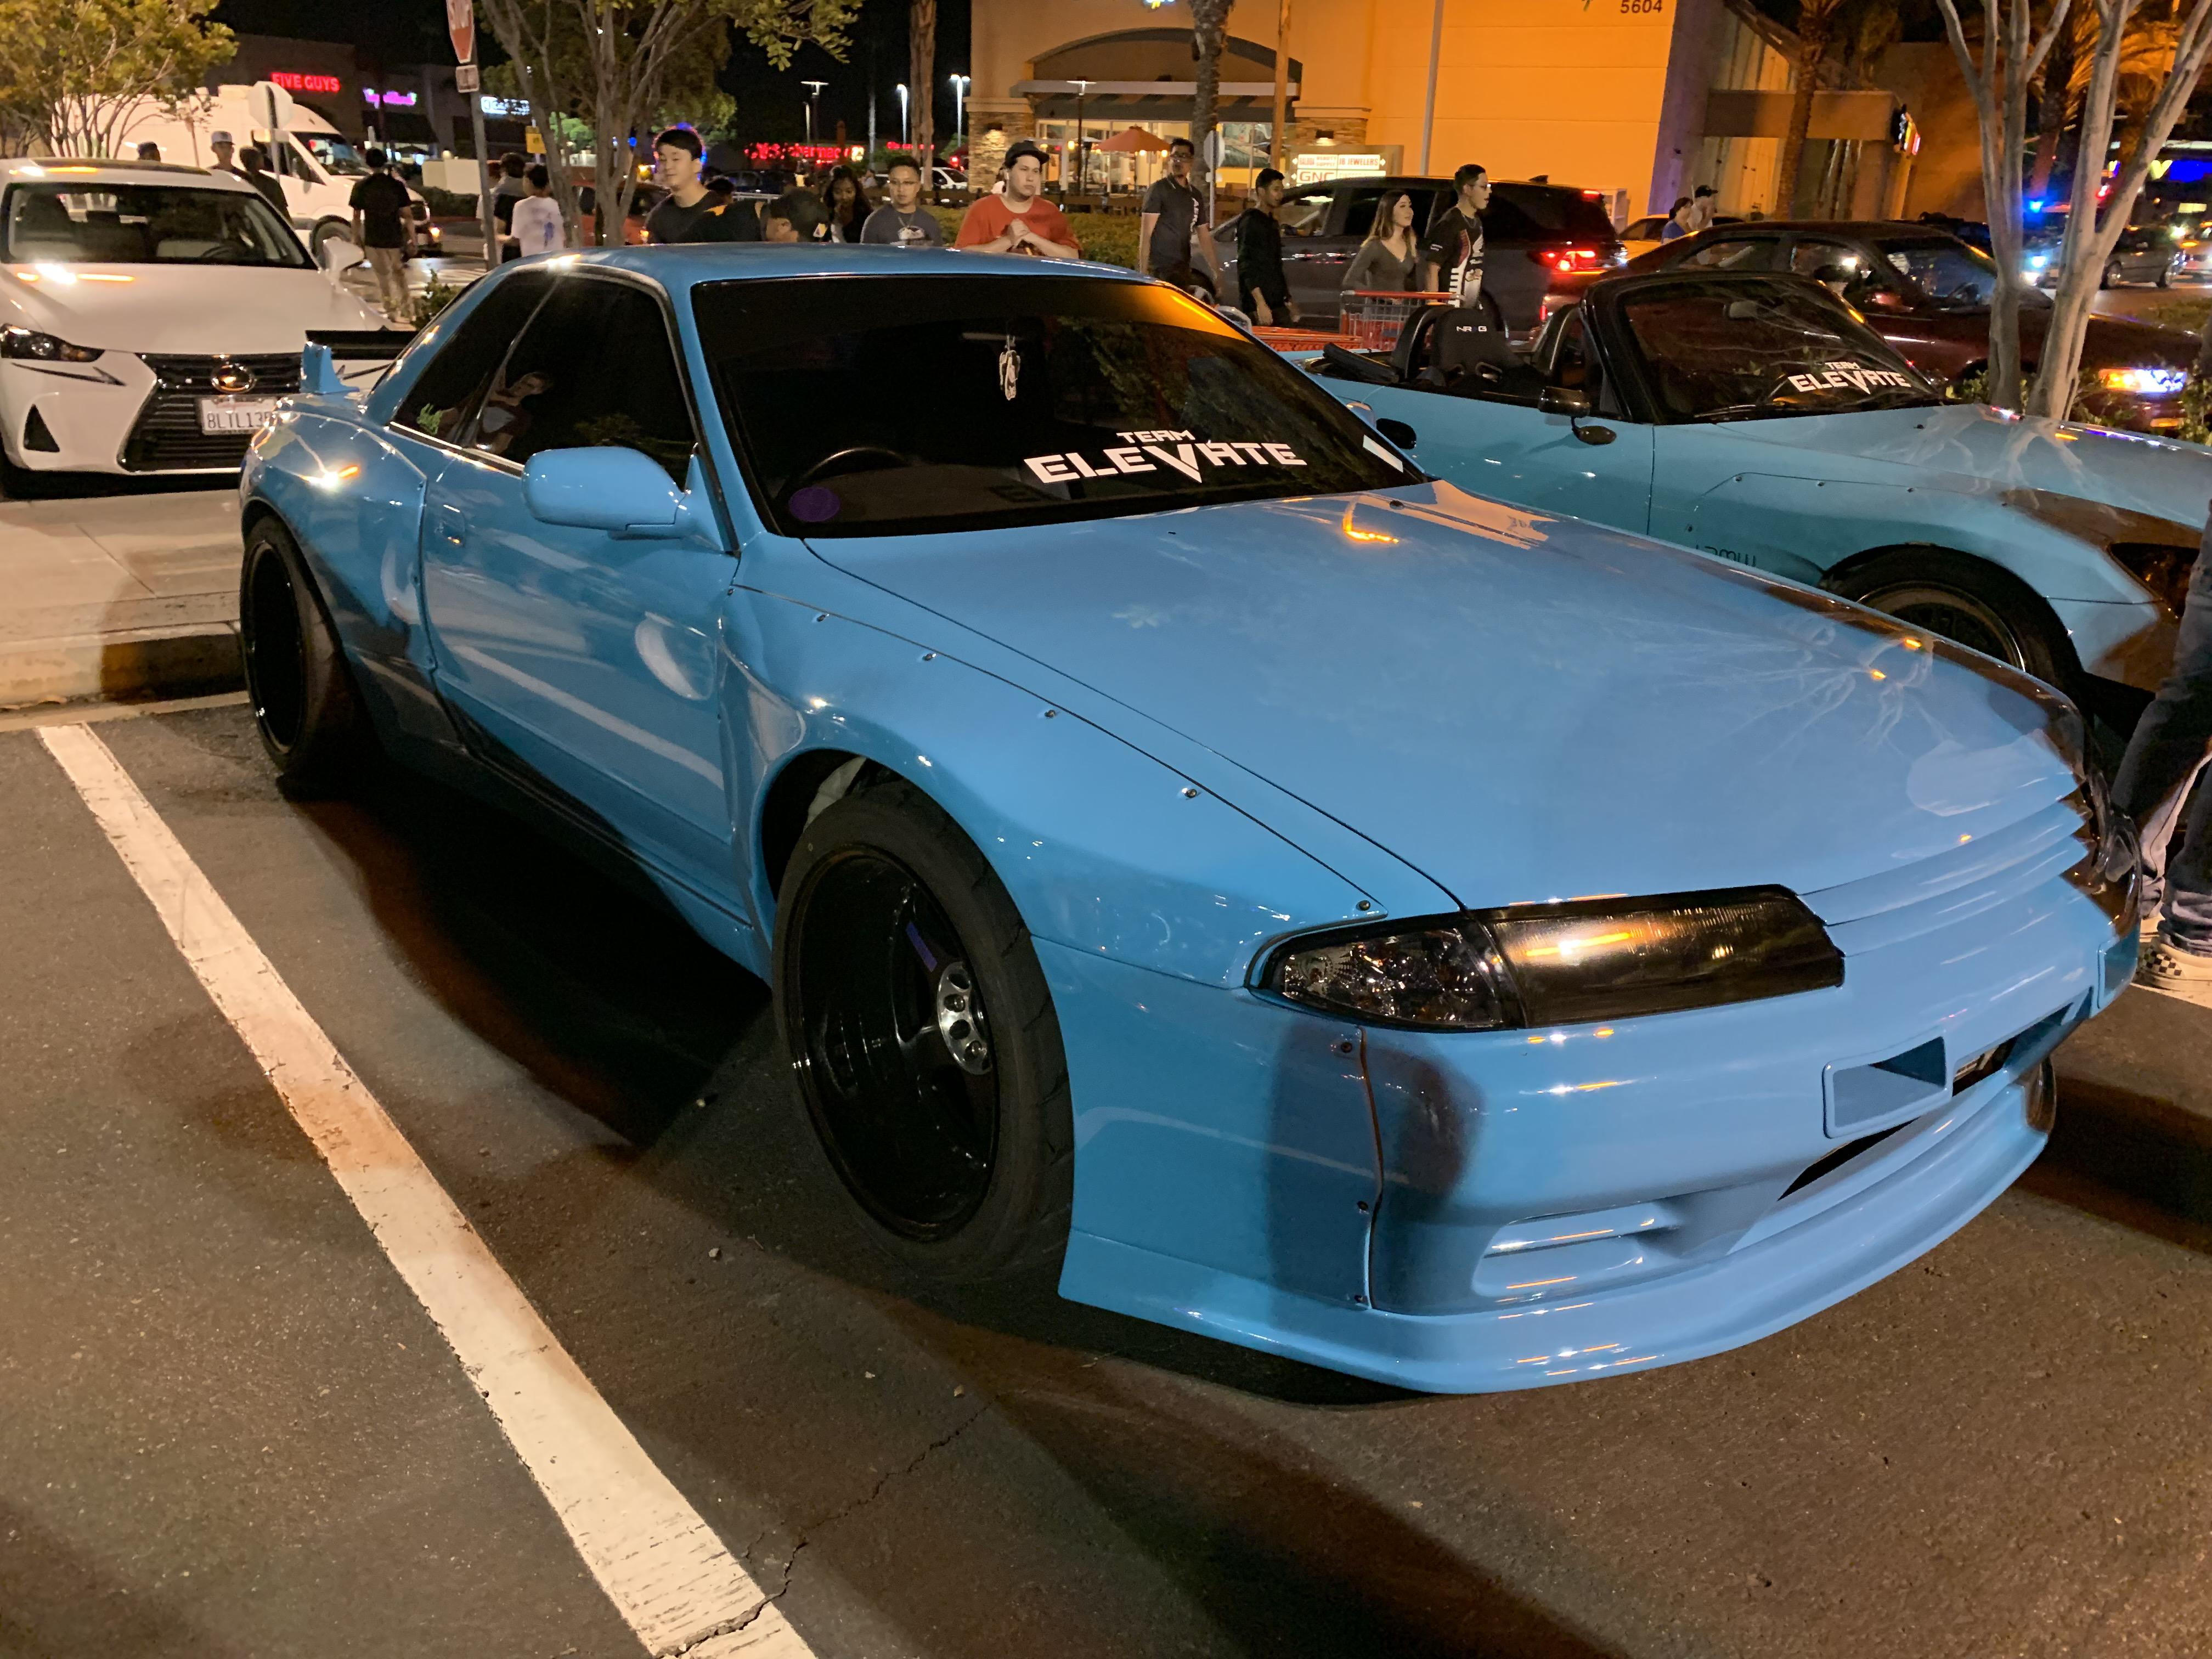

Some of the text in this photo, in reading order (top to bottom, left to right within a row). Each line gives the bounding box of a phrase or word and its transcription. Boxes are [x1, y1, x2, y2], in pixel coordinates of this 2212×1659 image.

[1620, 0, 1662, 13] 5604
[271, 72, 340, 92] FIVE GUYS
[1300, 171, 1335, 182] GNC
[1825, 361, 1861, 370] TEAM
[1787, 370, 1912, 395] ELEVATE
[1116, 430, 1196, 444] TEAM
[1023, 442, 1308, 484] ELEVATE
